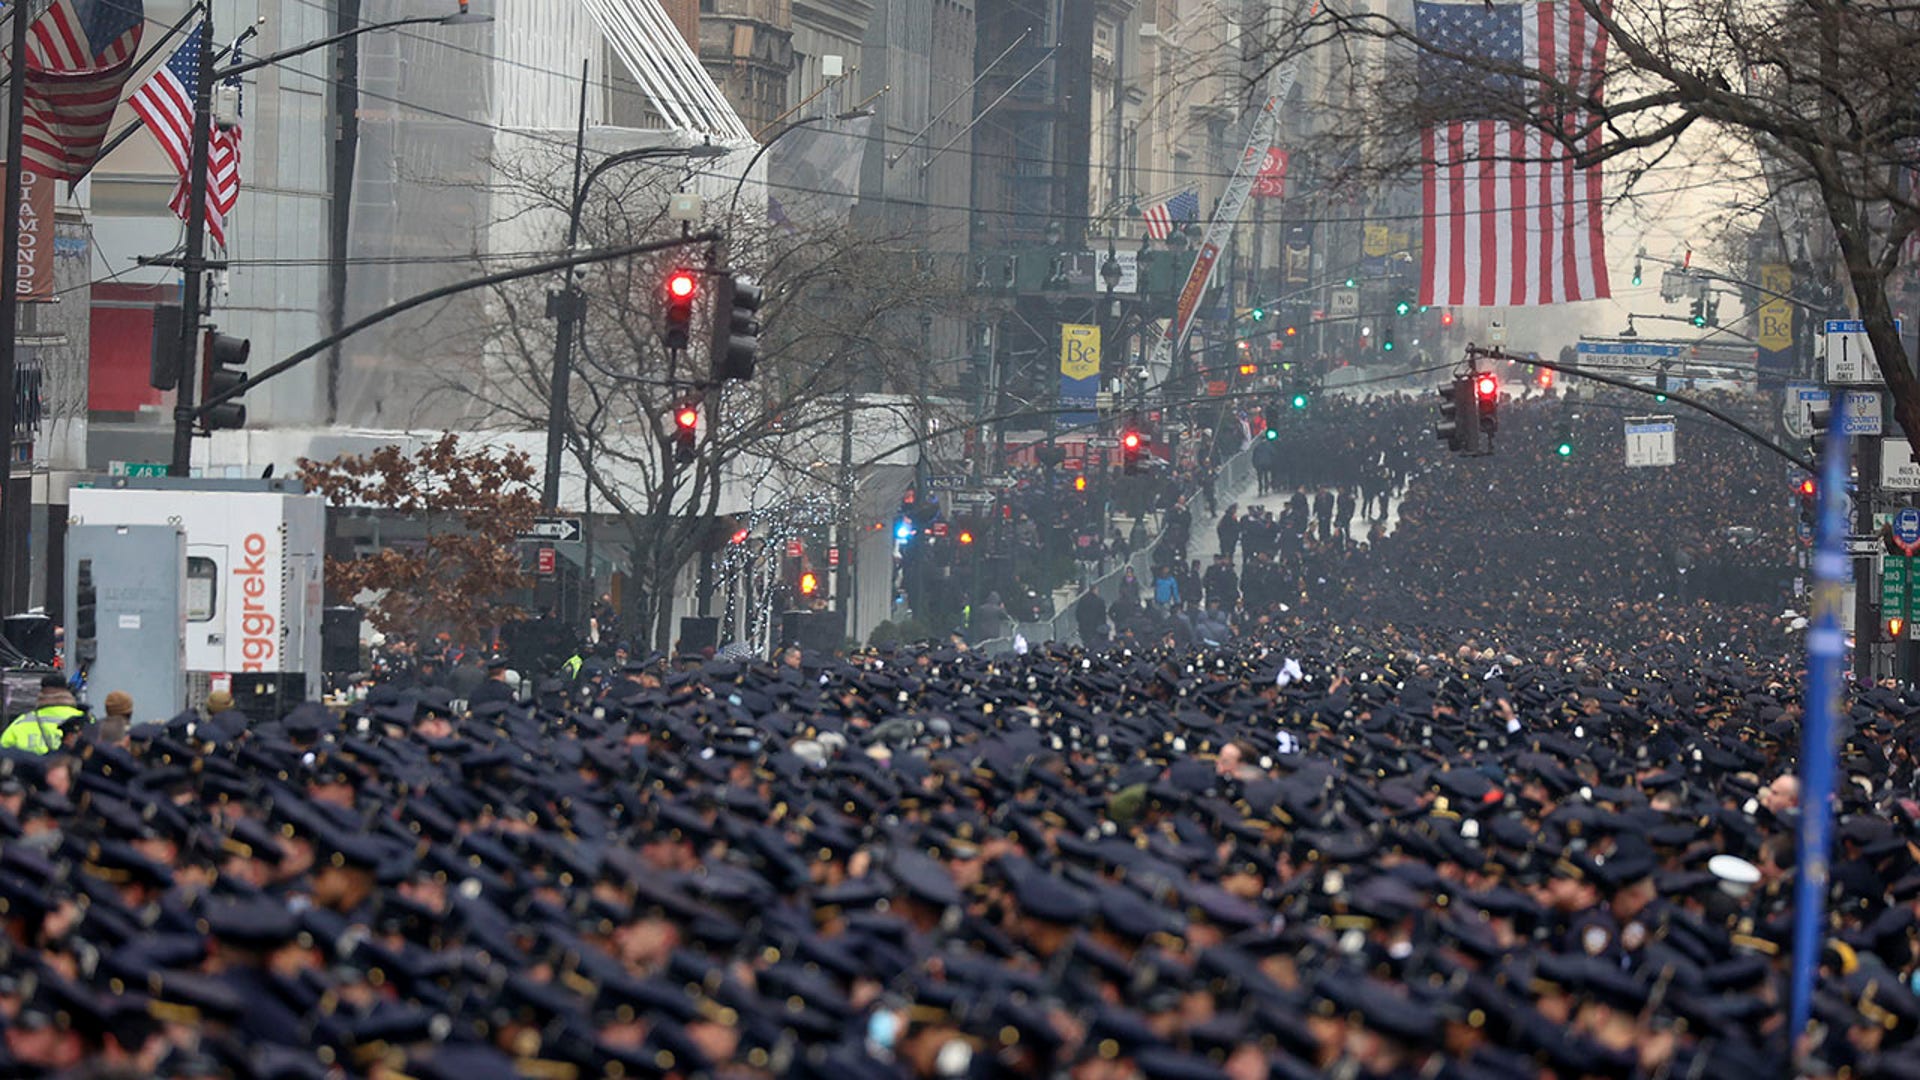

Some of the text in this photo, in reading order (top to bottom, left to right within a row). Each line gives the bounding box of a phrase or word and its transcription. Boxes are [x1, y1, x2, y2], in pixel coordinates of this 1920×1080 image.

[16, 171, 39, 294] DIAMONDS
[1338, 295, 1354, 305] NO
[1764, 316, 1789, 336] Be
[1067, 339, 1096, 363] Be
[1587, 355, 1647, 365] BUSES ONLY
[1849, 395, 1875, 404] NYPD
